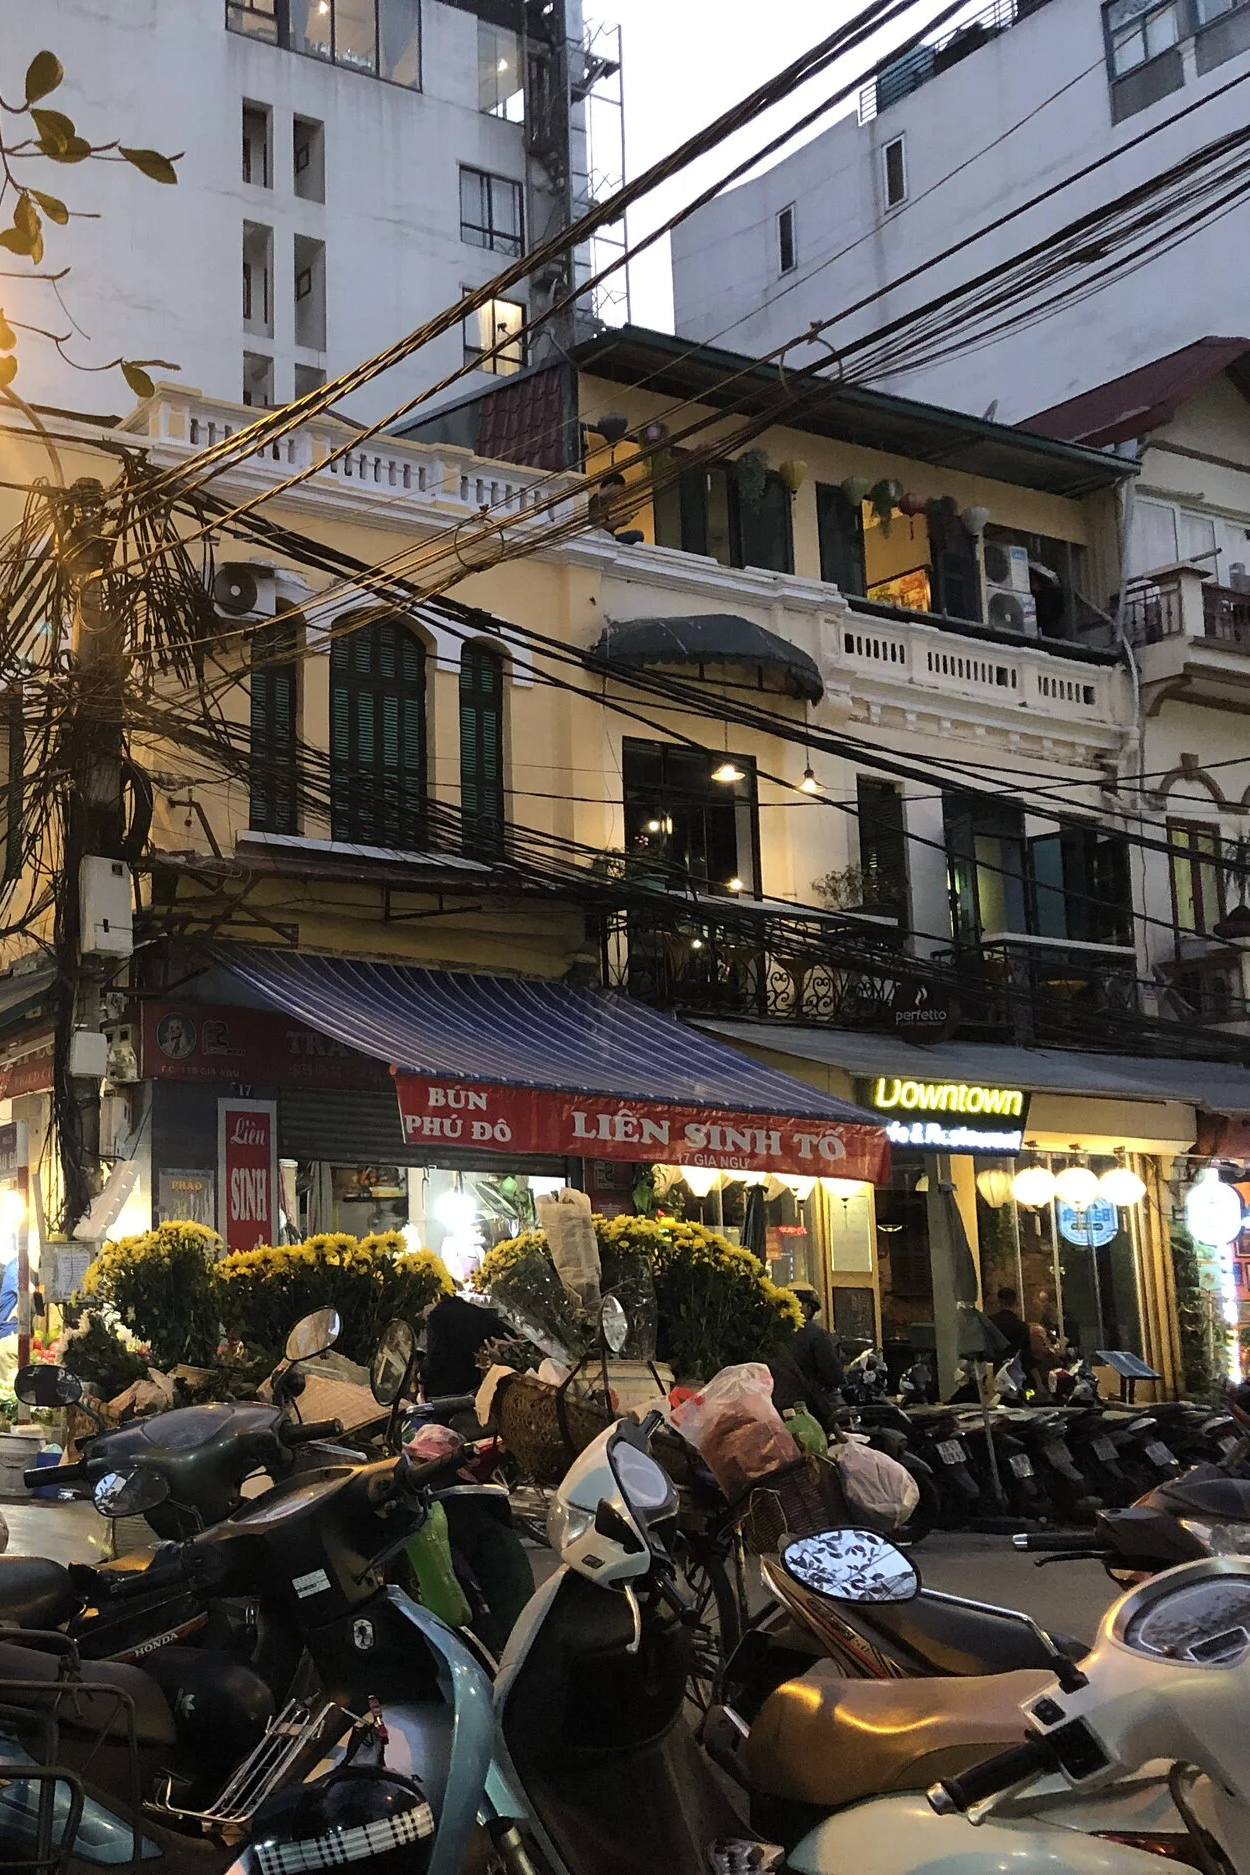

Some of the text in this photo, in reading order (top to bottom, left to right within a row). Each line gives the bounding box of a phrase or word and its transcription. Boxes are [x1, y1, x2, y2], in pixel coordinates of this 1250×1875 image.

[895, 1008, 947, 1025] perfetto
[238, 1084, 252, 1096] 17
[427, 1085, 488, 1111] BÚN
[875, 1077, 1024, 1116] Downtown
[230, 1117, 266, 1146] Liên
[404, 1113, 512, 1143] PHÚ ĐÔ
[570, 1108, 671, 1146] LIÊN
[683, 1122, 782, 1156] SINH
[793, 1126, 846, 1161] TỐ
[693, 1154, 717, 1167] GIA
[230, 1167, 268, 1221] SINH
[134, 1632, 180, 1657] HONDA
